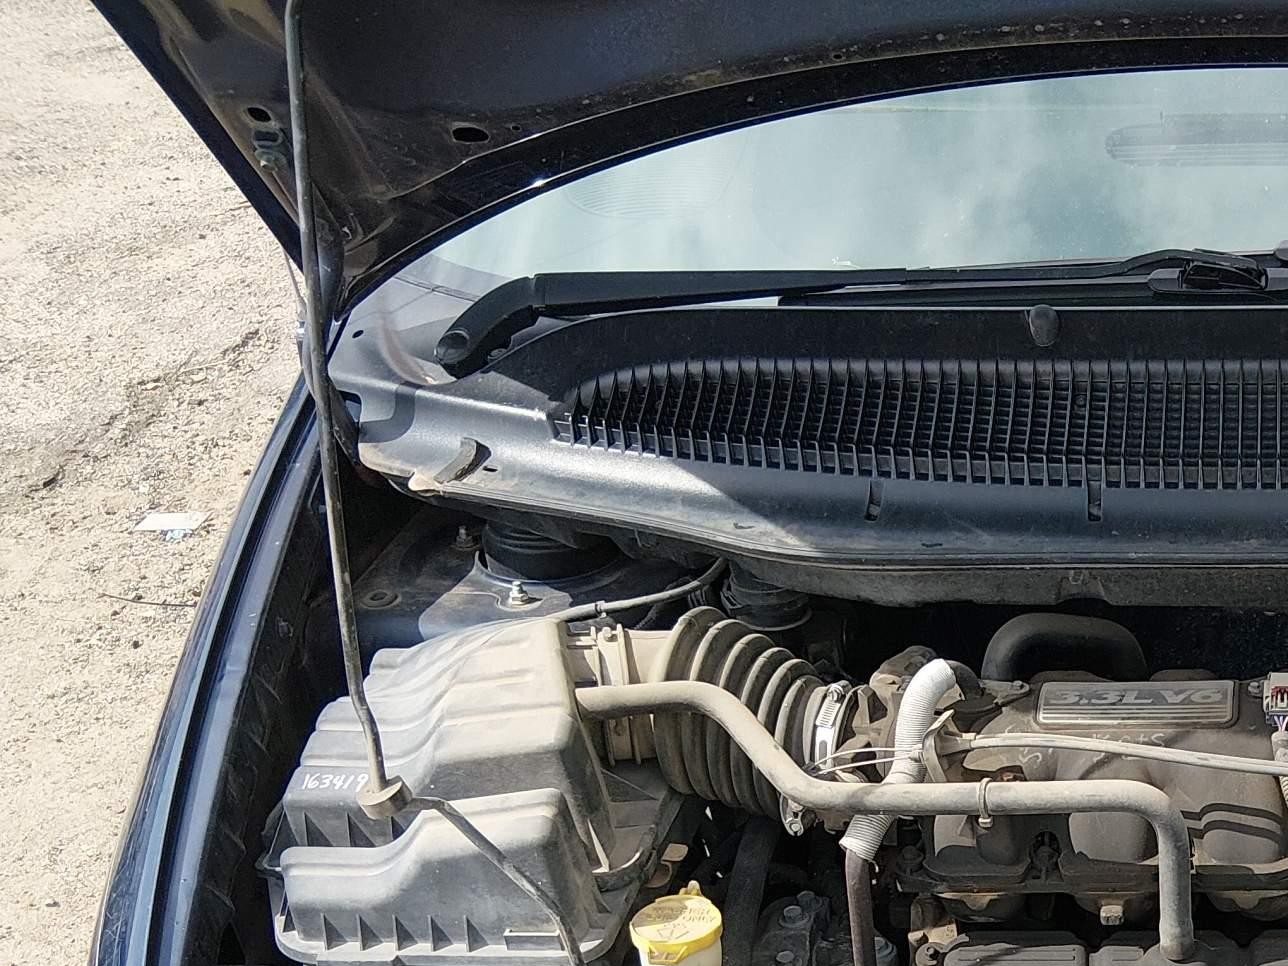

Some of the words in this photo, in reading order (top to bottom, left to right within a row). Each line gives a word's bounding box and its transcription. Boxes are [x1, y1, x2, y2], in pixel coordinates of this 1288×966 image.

[1051, 689, 1153, 704] 3.3L
[1159, 689, 1224, 704] V6
[302, 772, 369, 793] 163419
